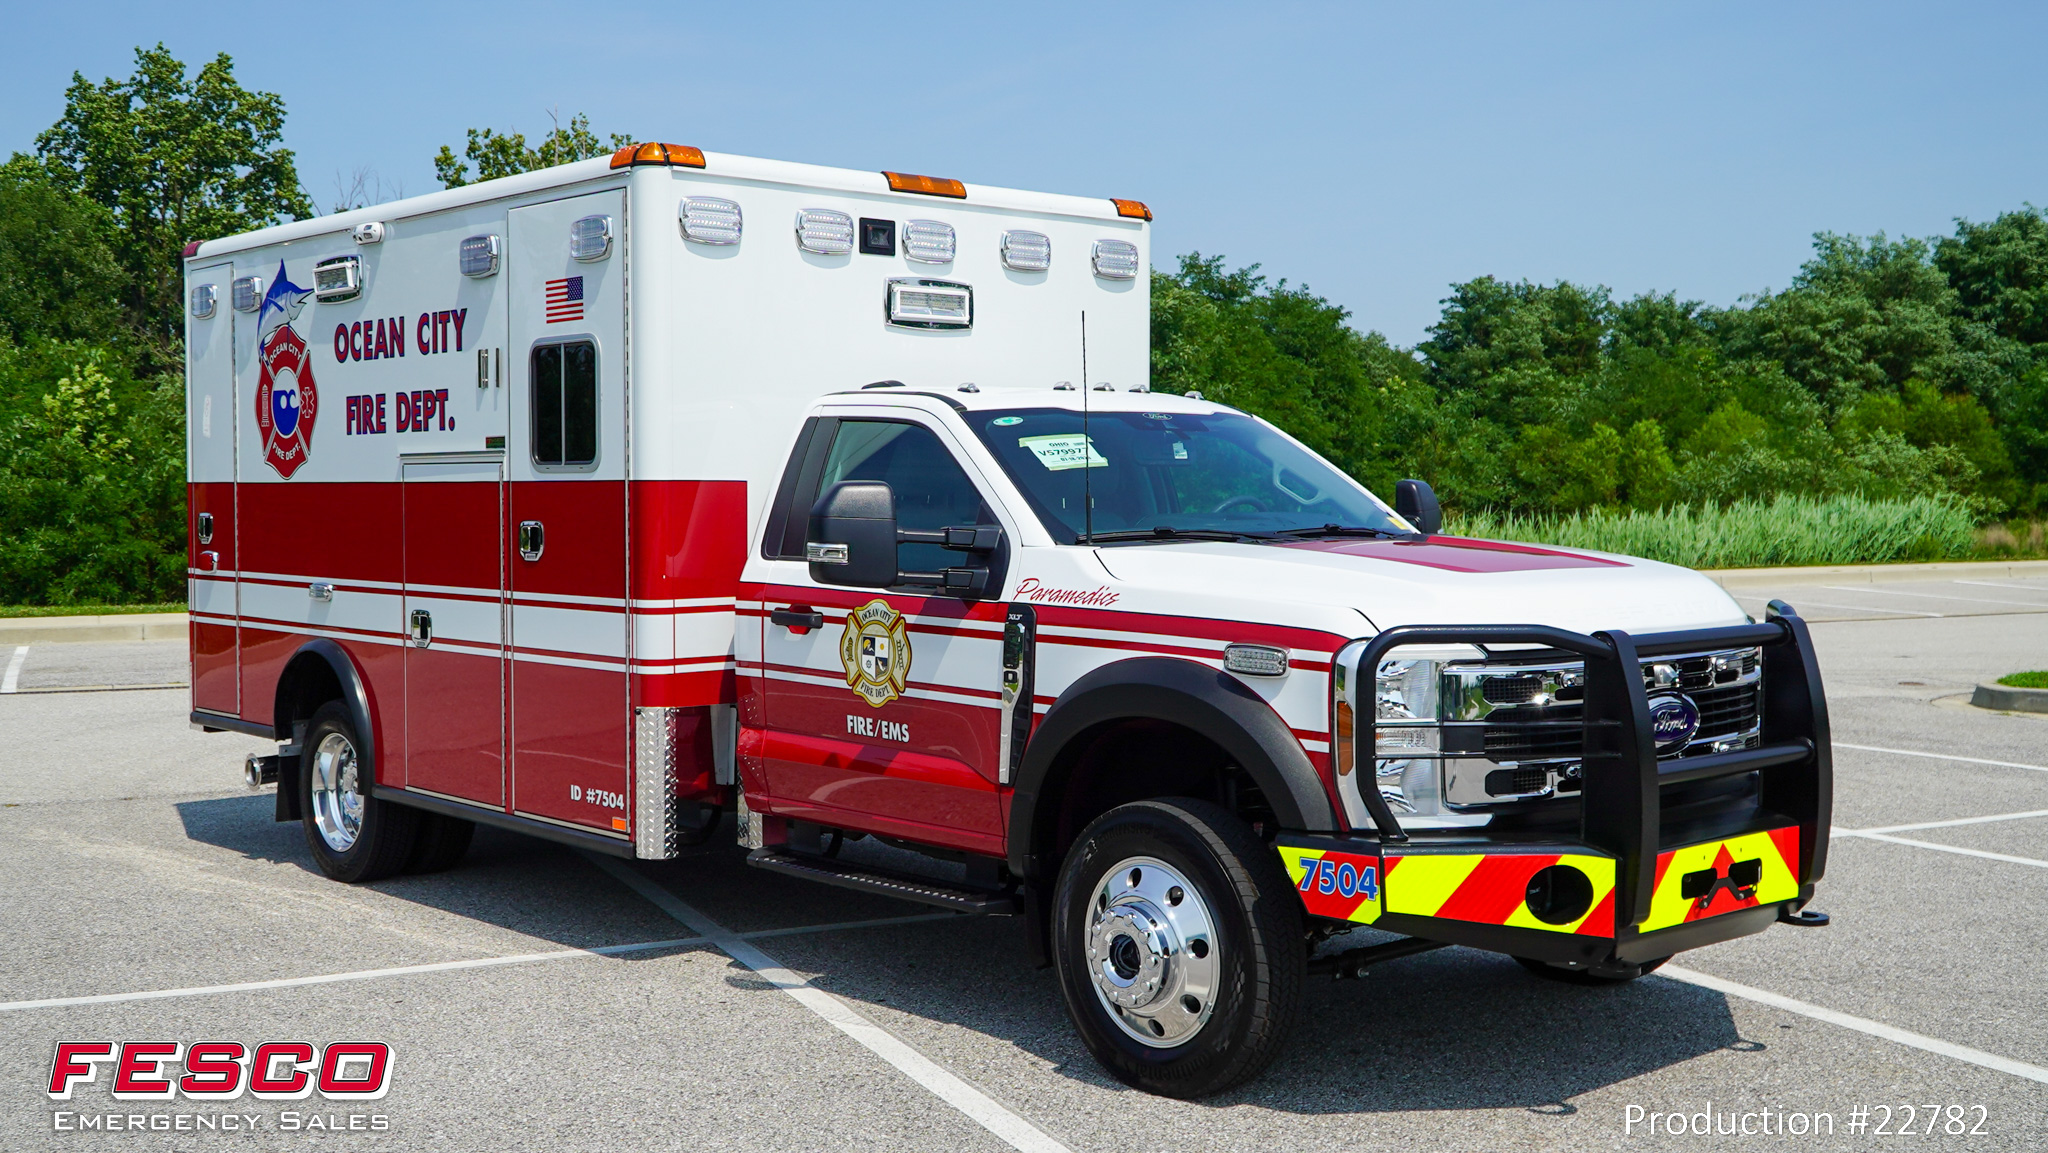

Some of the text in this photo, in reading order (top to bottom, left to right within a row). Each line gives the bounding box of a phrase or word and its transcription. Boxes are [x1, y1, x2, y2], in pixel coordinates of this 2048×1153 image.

[334, 307, 468, 363] OCEAN CITY
[269, 342, 302, 364] OCEAN CITY
[346, 388, 456, 436] FIRE DEPT.
[272, 441, 285, 460] FIRE
[1013, 577, 1121, 607] Paramedics
[861, 608, 893, 623] OCEAN CITY
[860, 681, 874, 698] FIRE
[846, 714, 910, 743] FIRE/EMS
[1654, 708, 1688, 733] Ford
[570, 784, 625, 811] ID #7504
[1299, 856, 1379, 902] 7504
